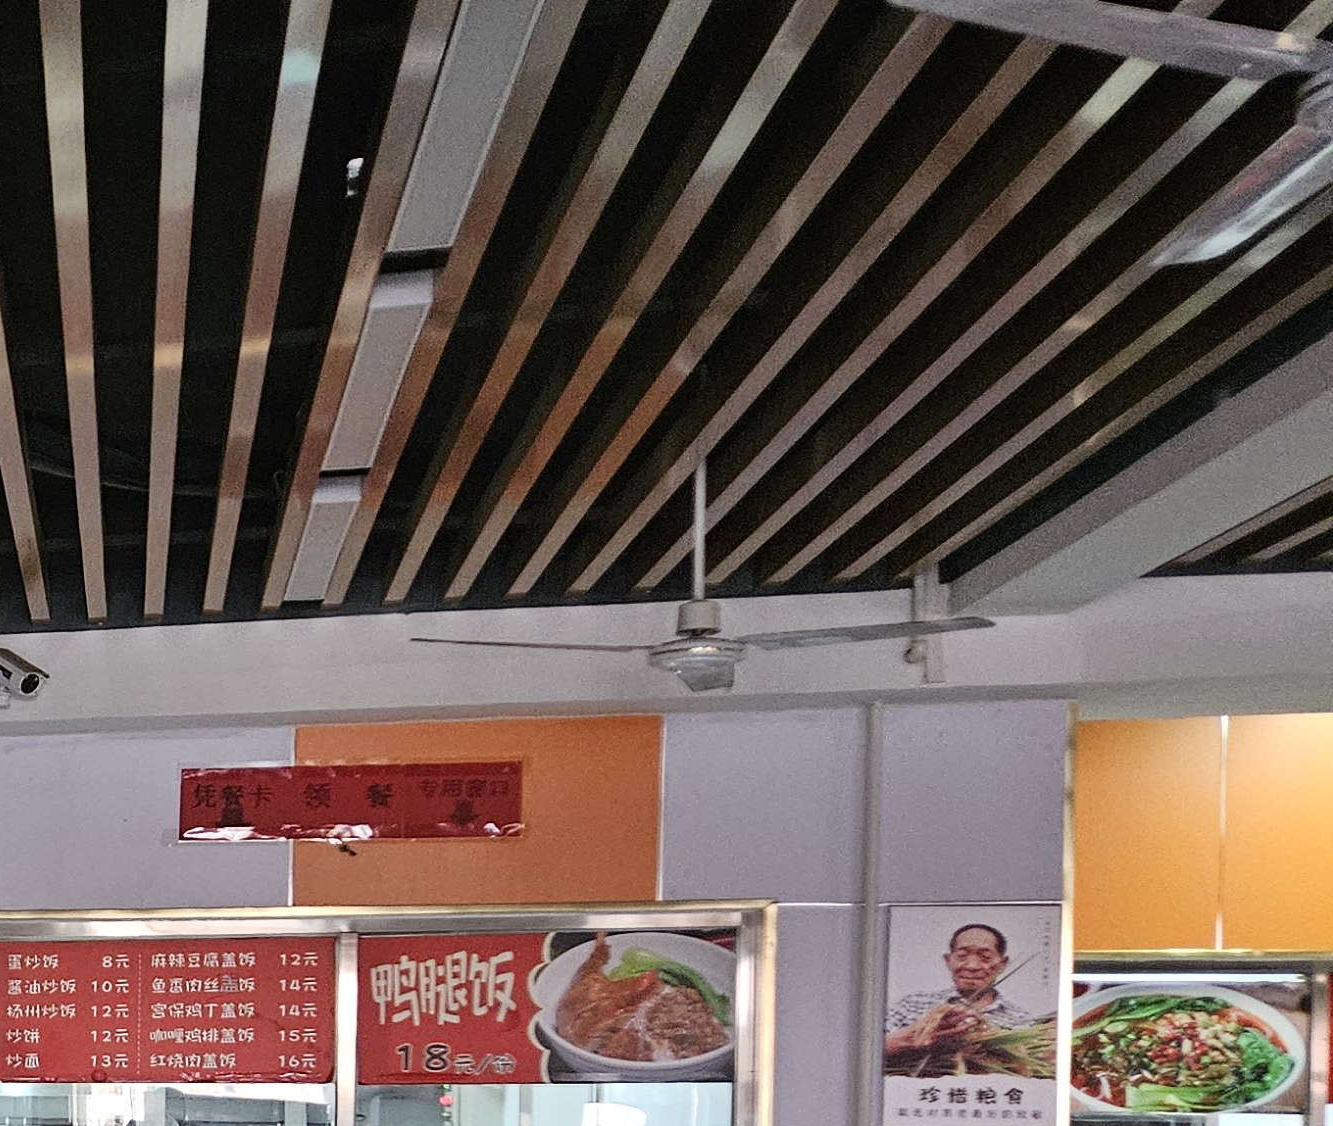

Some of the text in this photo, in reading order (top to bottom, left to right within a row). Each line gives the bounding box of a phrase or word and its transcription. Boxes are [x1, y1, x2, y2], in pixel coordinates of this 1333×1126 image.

[7, 953, 130, 970] 蛋炒饭 8元
[150, 951, 318, 969] 麻辣豆腐盖饭 12元
[7, 978, 130, 994] 酱油炒饭 10元
[279, 977, 318, 993] 14元
[369, 949, 517, 1027] 鸭腿饭
[6, 1003, 129, 1019] 扬州炒饭 12元
[150, 1002, 318, 1019] 宫保鸡丁盖饭 14元
[5, 1028, 129, 1044] 炒饼 12元
[149, 1028, 317, 1044] 咖喱鸡排盖饭 15元
[5, 1053, 129, 1069] 炒面 13元
[149, 1053, 317, 1069] 红烧肉盖饭 16元
[396, 1042, 517, 1075] 18元/份
[919, 1085, 1024, 1105] 珍惜粮食
